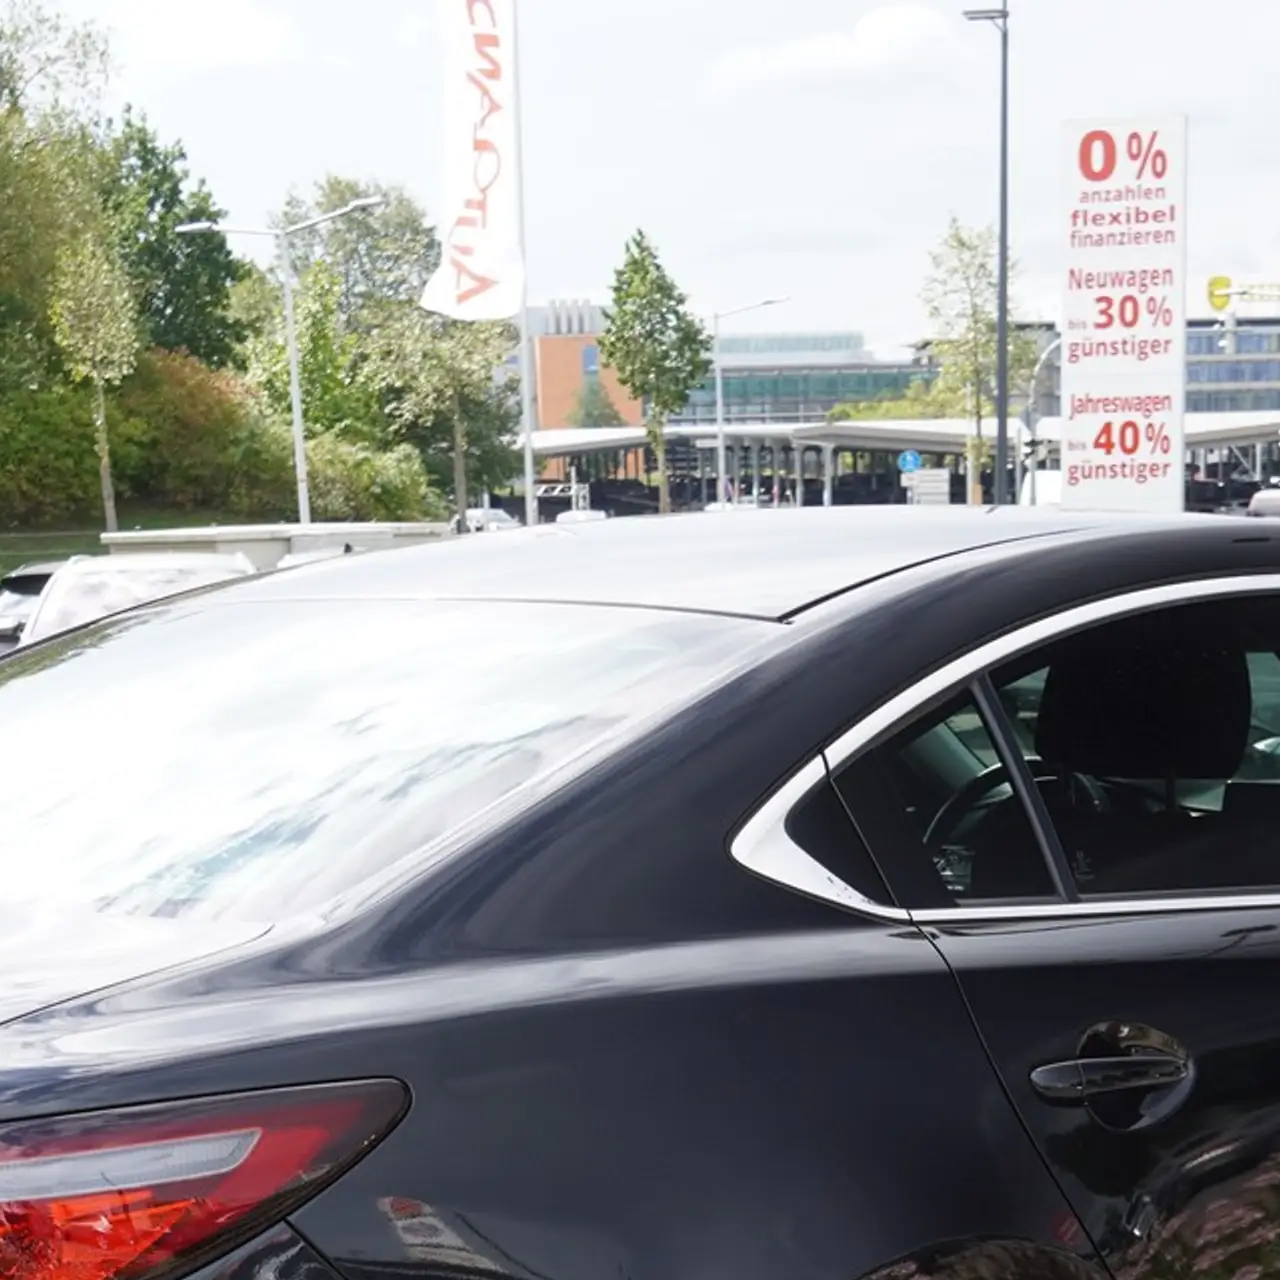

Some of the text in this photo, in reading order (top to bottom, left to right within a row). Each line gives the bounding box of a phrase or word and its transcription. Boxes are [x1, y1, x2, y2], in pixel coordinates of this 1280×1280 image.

[1080, 186, 1165, 203] anzahlen
[1071, 205, 1175, 227] flexibel
[1070, 228, 1175, 248] finanzieren
[1068, 267, 1173, 293] Neuwagen
[1067, 336, 1172, 364] günstiger
[1069, 393, 1172, 420] Jahreswagen
[1067, 460, 1171, 486] günstiger
